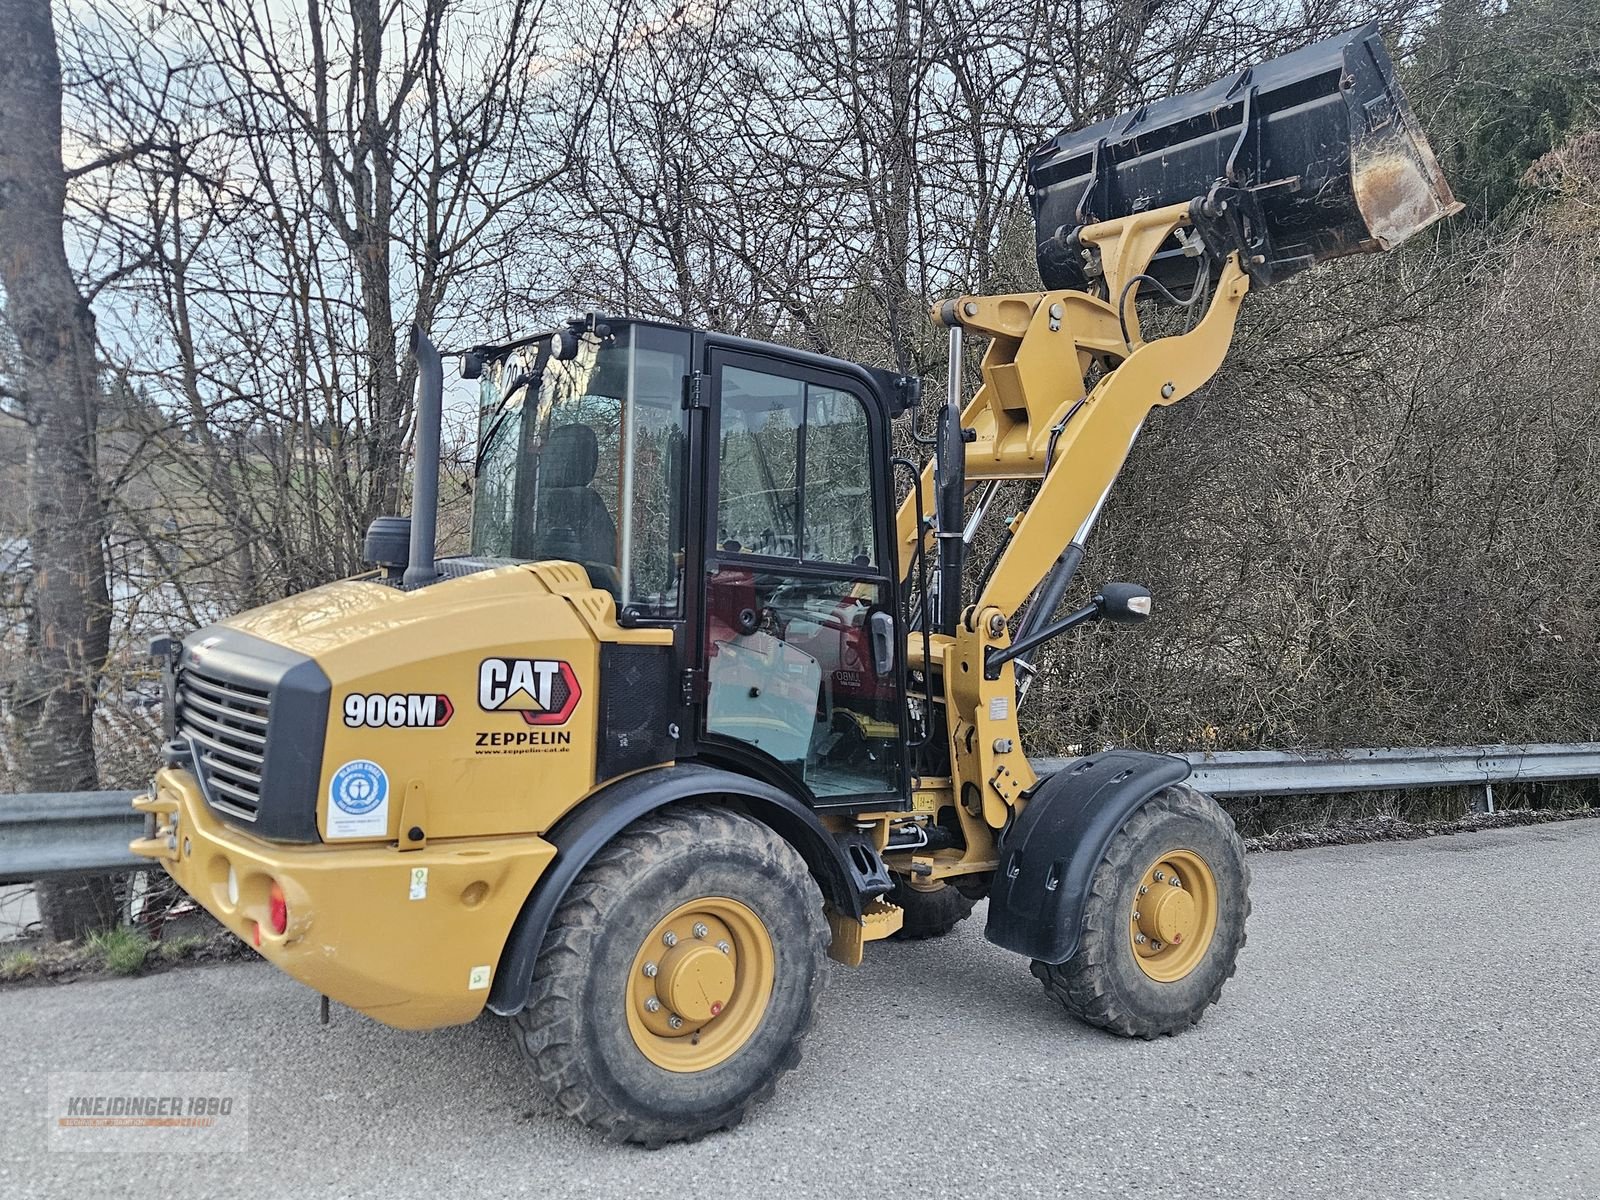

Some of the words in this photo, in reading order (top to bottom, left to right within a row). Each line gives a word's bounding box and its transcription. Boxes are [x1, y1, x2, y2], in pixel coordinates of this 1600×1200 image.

[480, 659, 559, 710] CAT
[345, 694, 437, 727] 906M
[475, 731, 571, 747] ZEPPELIN
[475, 747, 570, 755] www.zeppelin-cat.de
[339, 763, 363, 779] BLAUER
